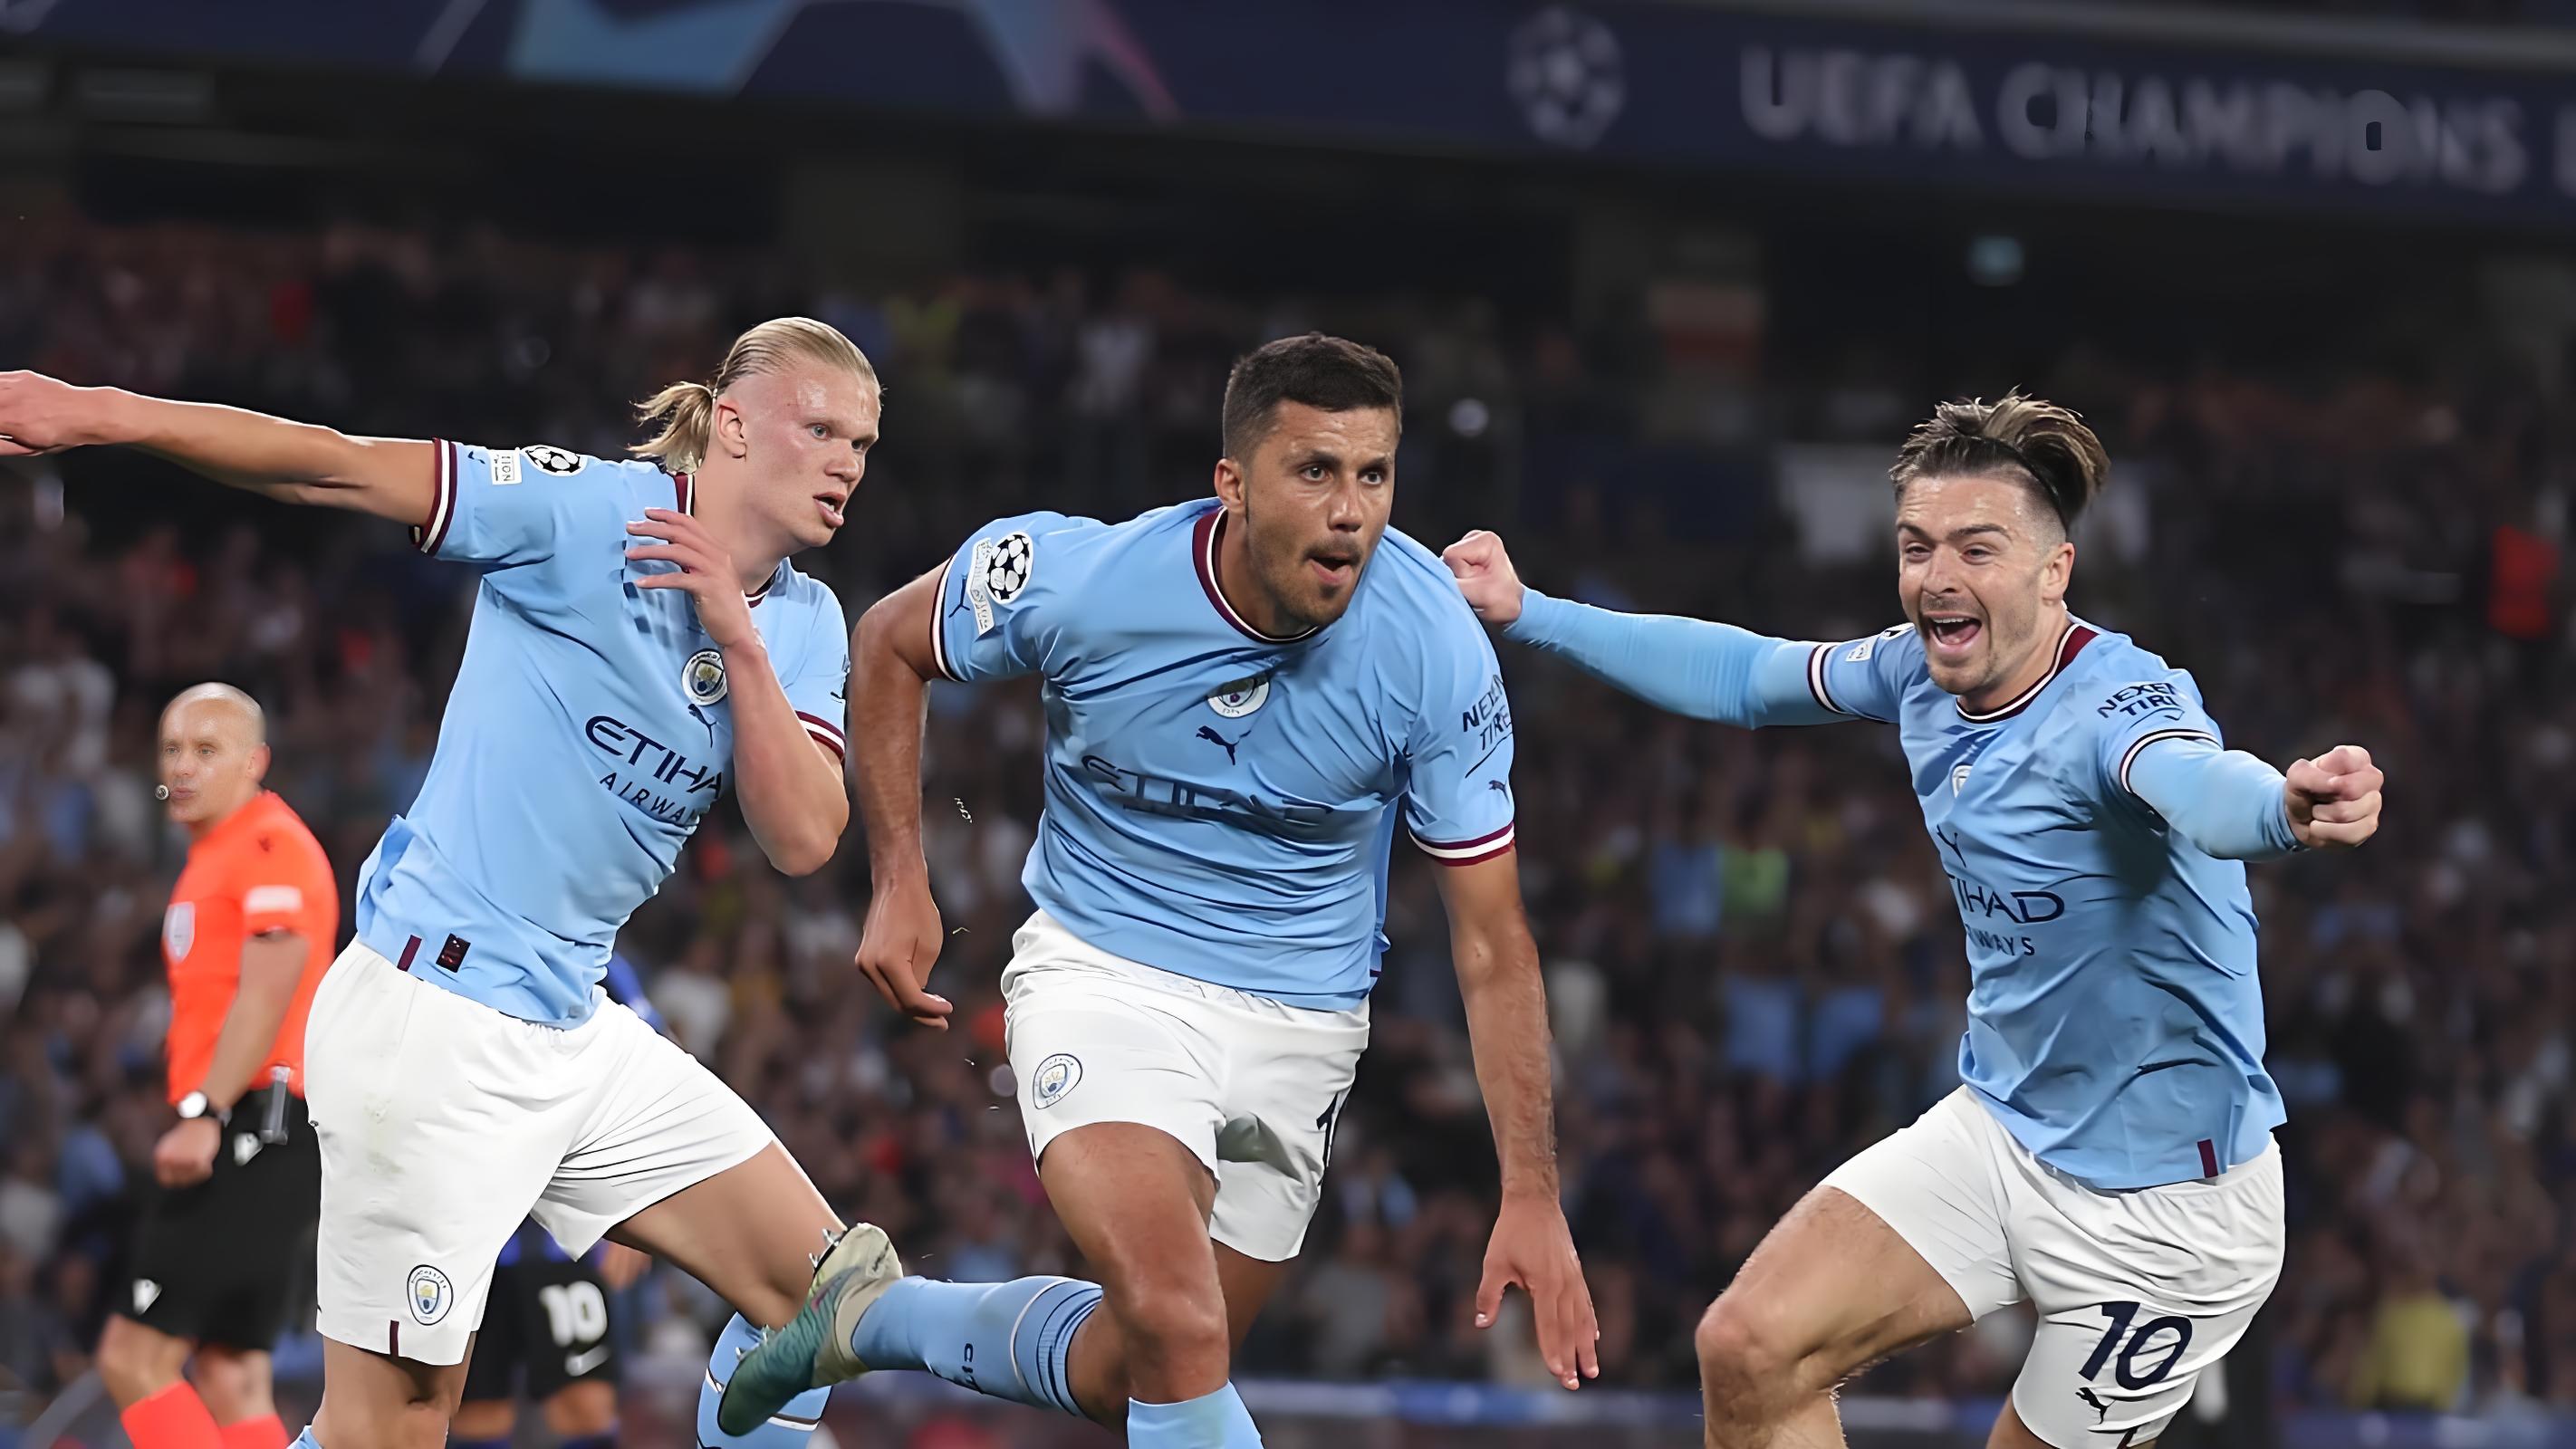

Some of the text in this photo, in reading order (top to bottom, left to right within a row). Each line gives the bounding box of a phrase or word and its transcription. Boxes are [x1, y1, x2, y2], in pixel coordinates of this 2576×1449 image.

[1740, 47, 1984, 149] UEFA
[1997, 62, 2528, 194] CHAMPIONS
[585, 715, 723, 800] ETIHA
[539, 1280, 608, 1347] 10
[2077, 1300, 2193, 1391] 10
